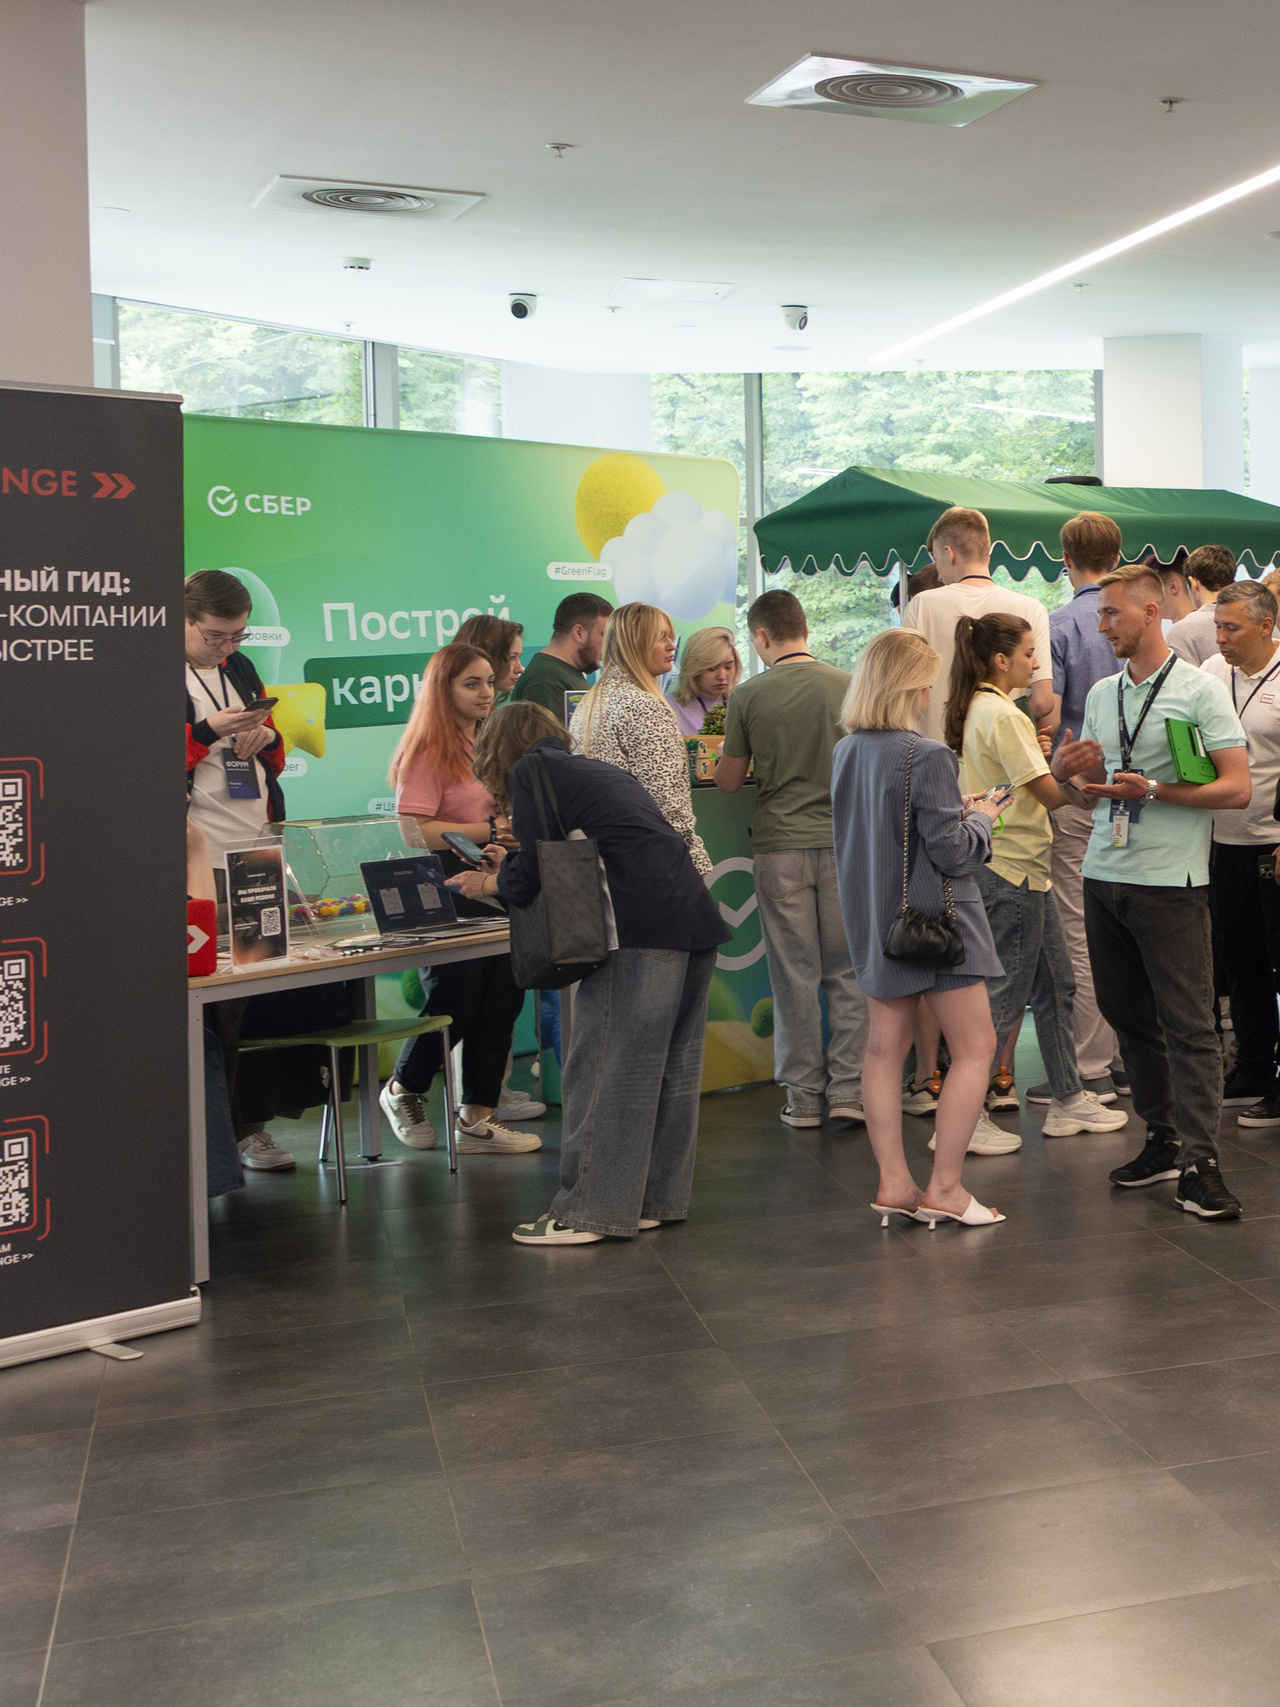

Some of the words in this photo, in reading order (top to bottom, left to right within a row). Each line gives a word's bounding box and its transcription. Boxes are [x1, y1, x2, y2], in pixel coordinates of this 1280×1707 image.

[245, 494, 311, 516] СБЕР
[554, 566, 607, 578] #GreenFlag
[67, 571, 131, 596] ГИД:
